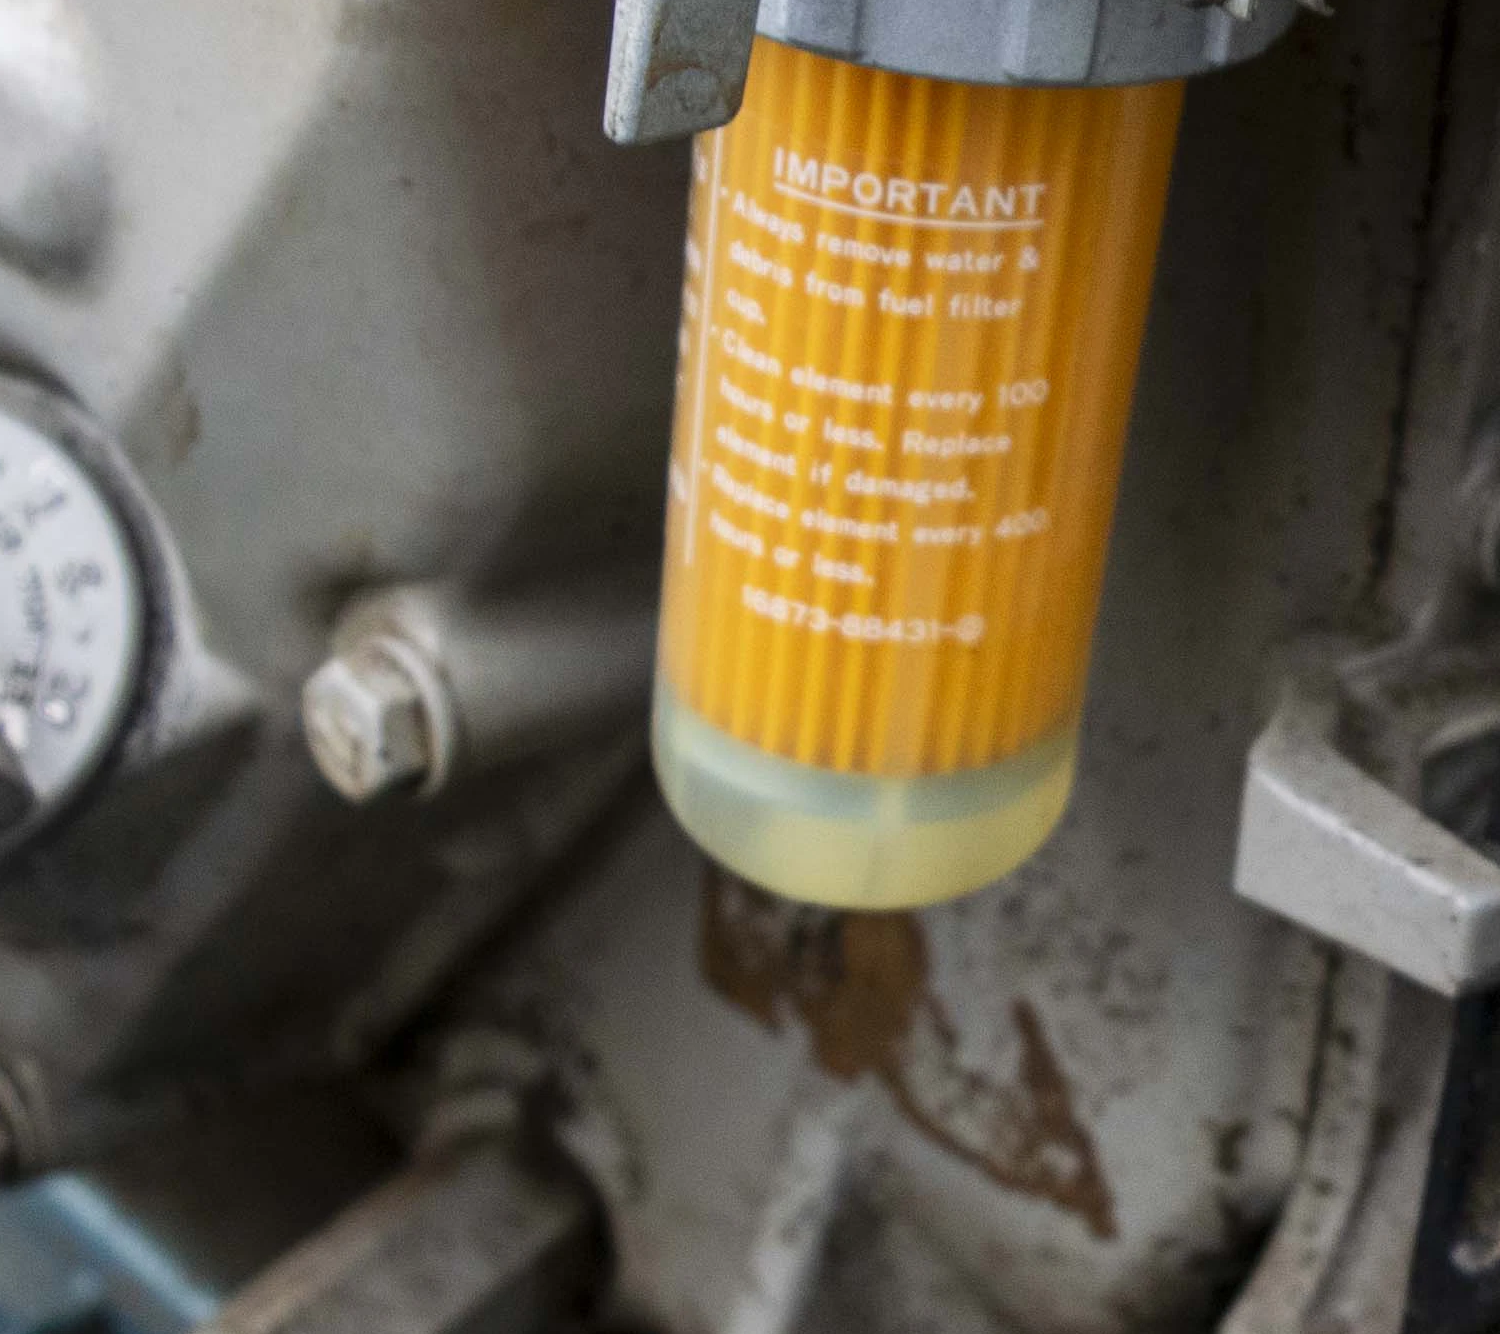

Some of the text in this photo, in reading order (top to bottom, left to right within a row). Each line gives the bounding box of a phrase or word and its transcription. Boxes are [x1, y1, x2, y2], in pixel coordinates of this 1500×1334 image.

[774, 146, 1046, 218] IMPORTANT
[732, 190, 1041, 272] Always remove water &
[730, 239, 1023, 318] debris from fuel filter
[722, 328, 1049, 417] Clean element every 100
[719, 373, 1012, 459] hours or less. Replace
[713, 463, 1047, 549] Replace element every 400
[716, 425, 976, 507] element if damaged.
[710, 509, 876, 589] hours or less.
